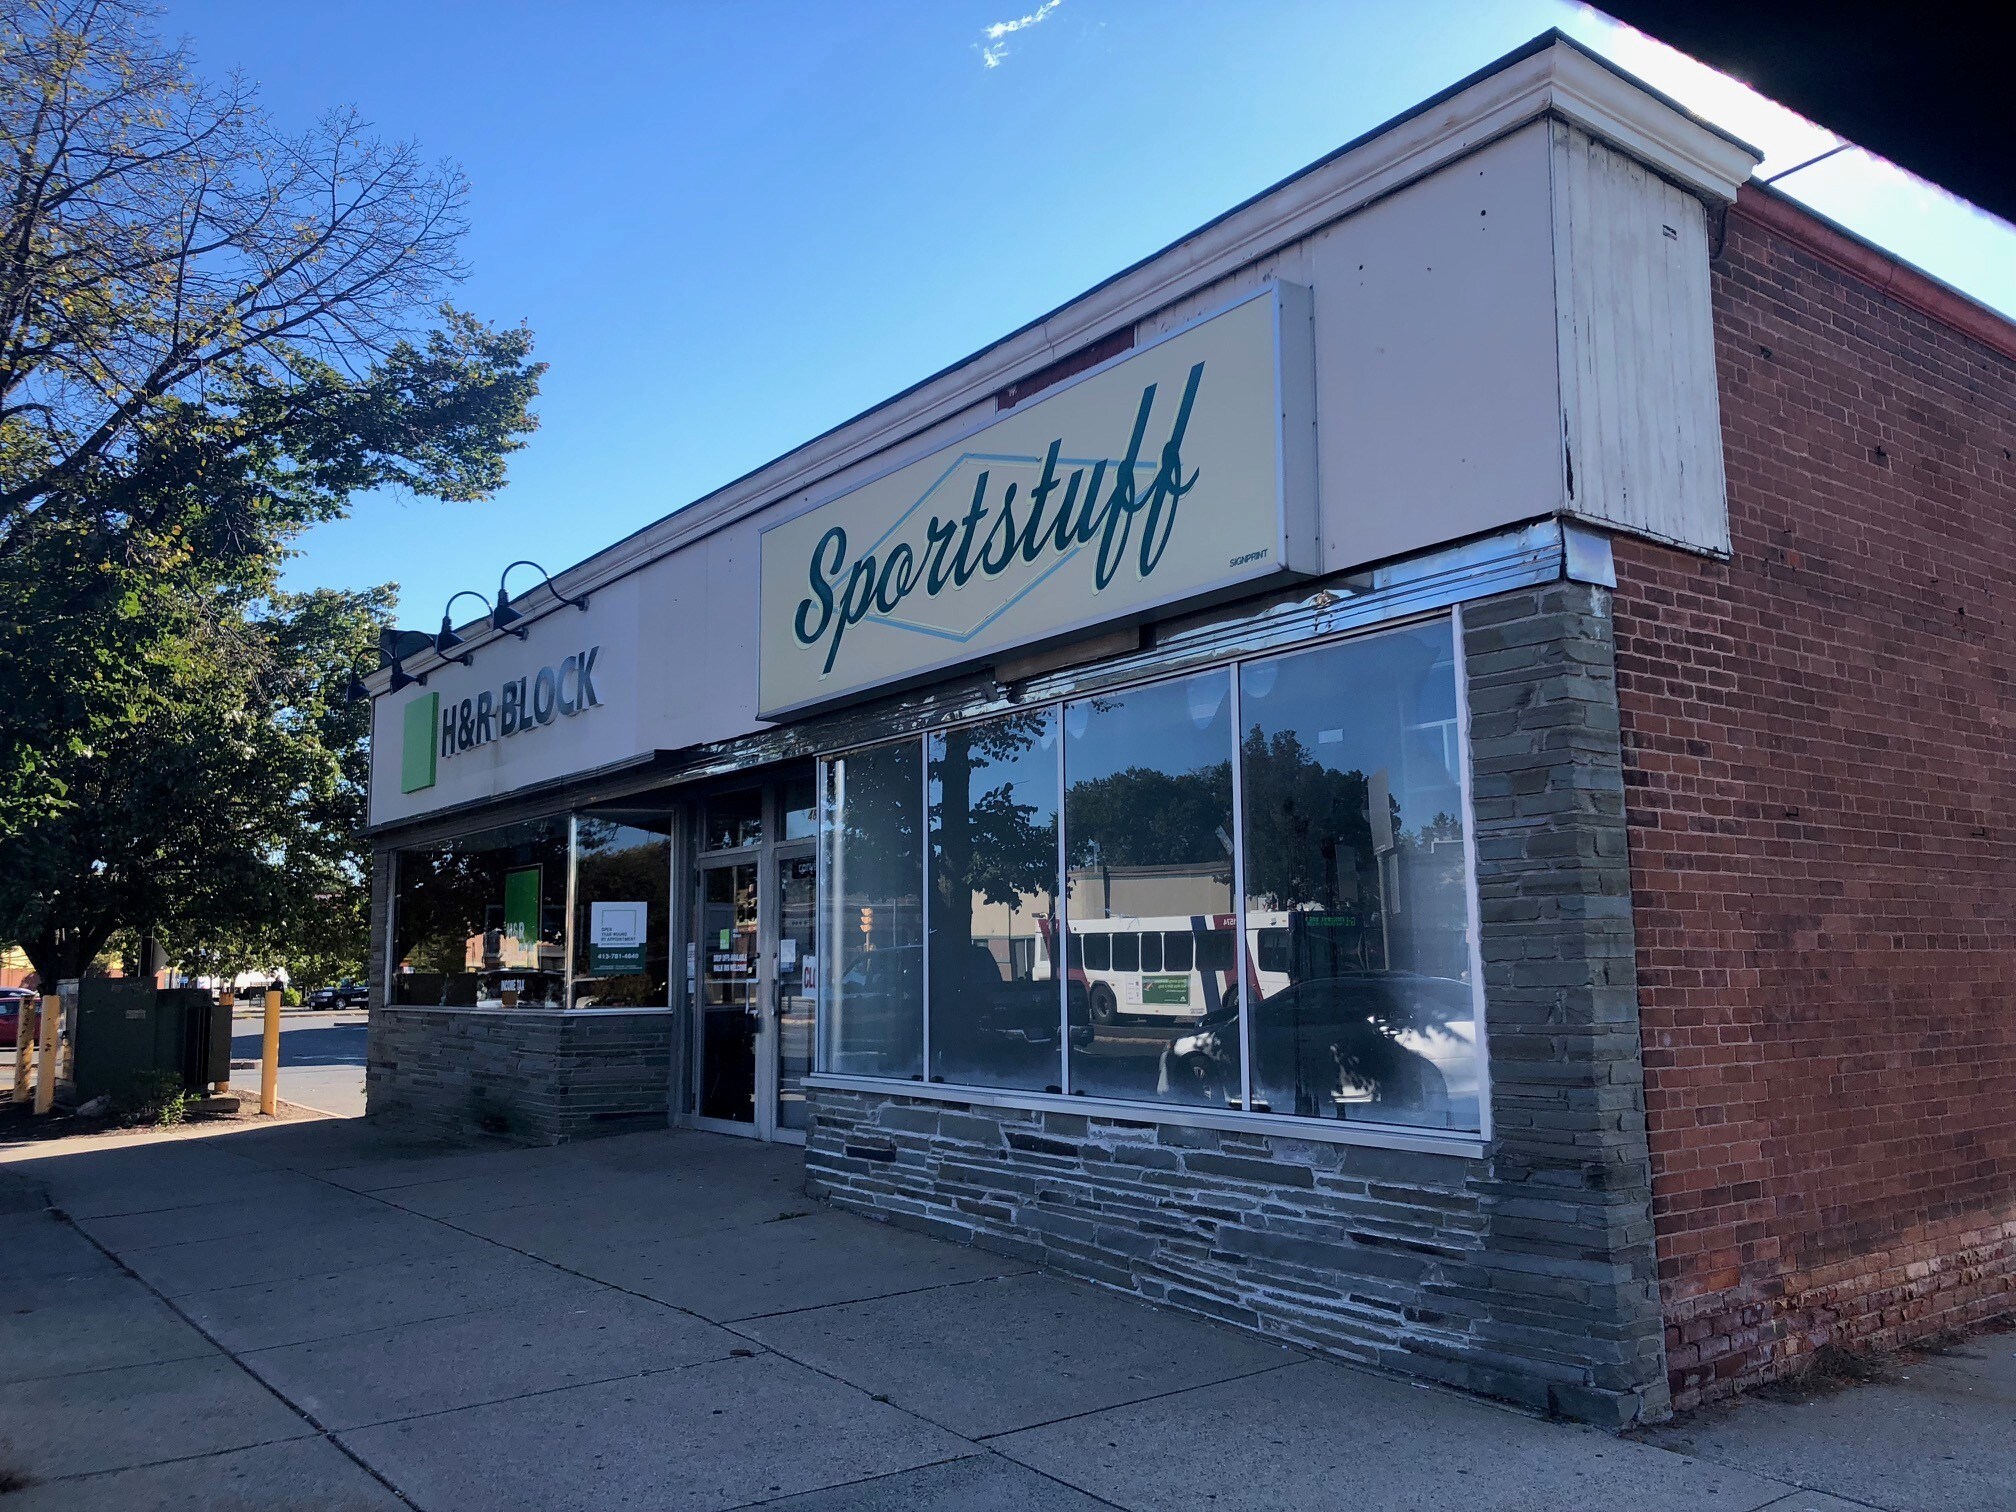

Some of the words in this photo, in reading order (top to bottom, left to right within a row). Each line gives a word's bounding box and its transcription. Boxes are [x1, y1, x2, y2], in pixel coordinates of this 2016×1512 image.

[793, 360, 1206, 677] Sportstuff
[1229, 548, 1268, 568] SIGNPRINT
[441, 690, 496, 759] H&R
[501, 645, 602, 737] BLOCK
